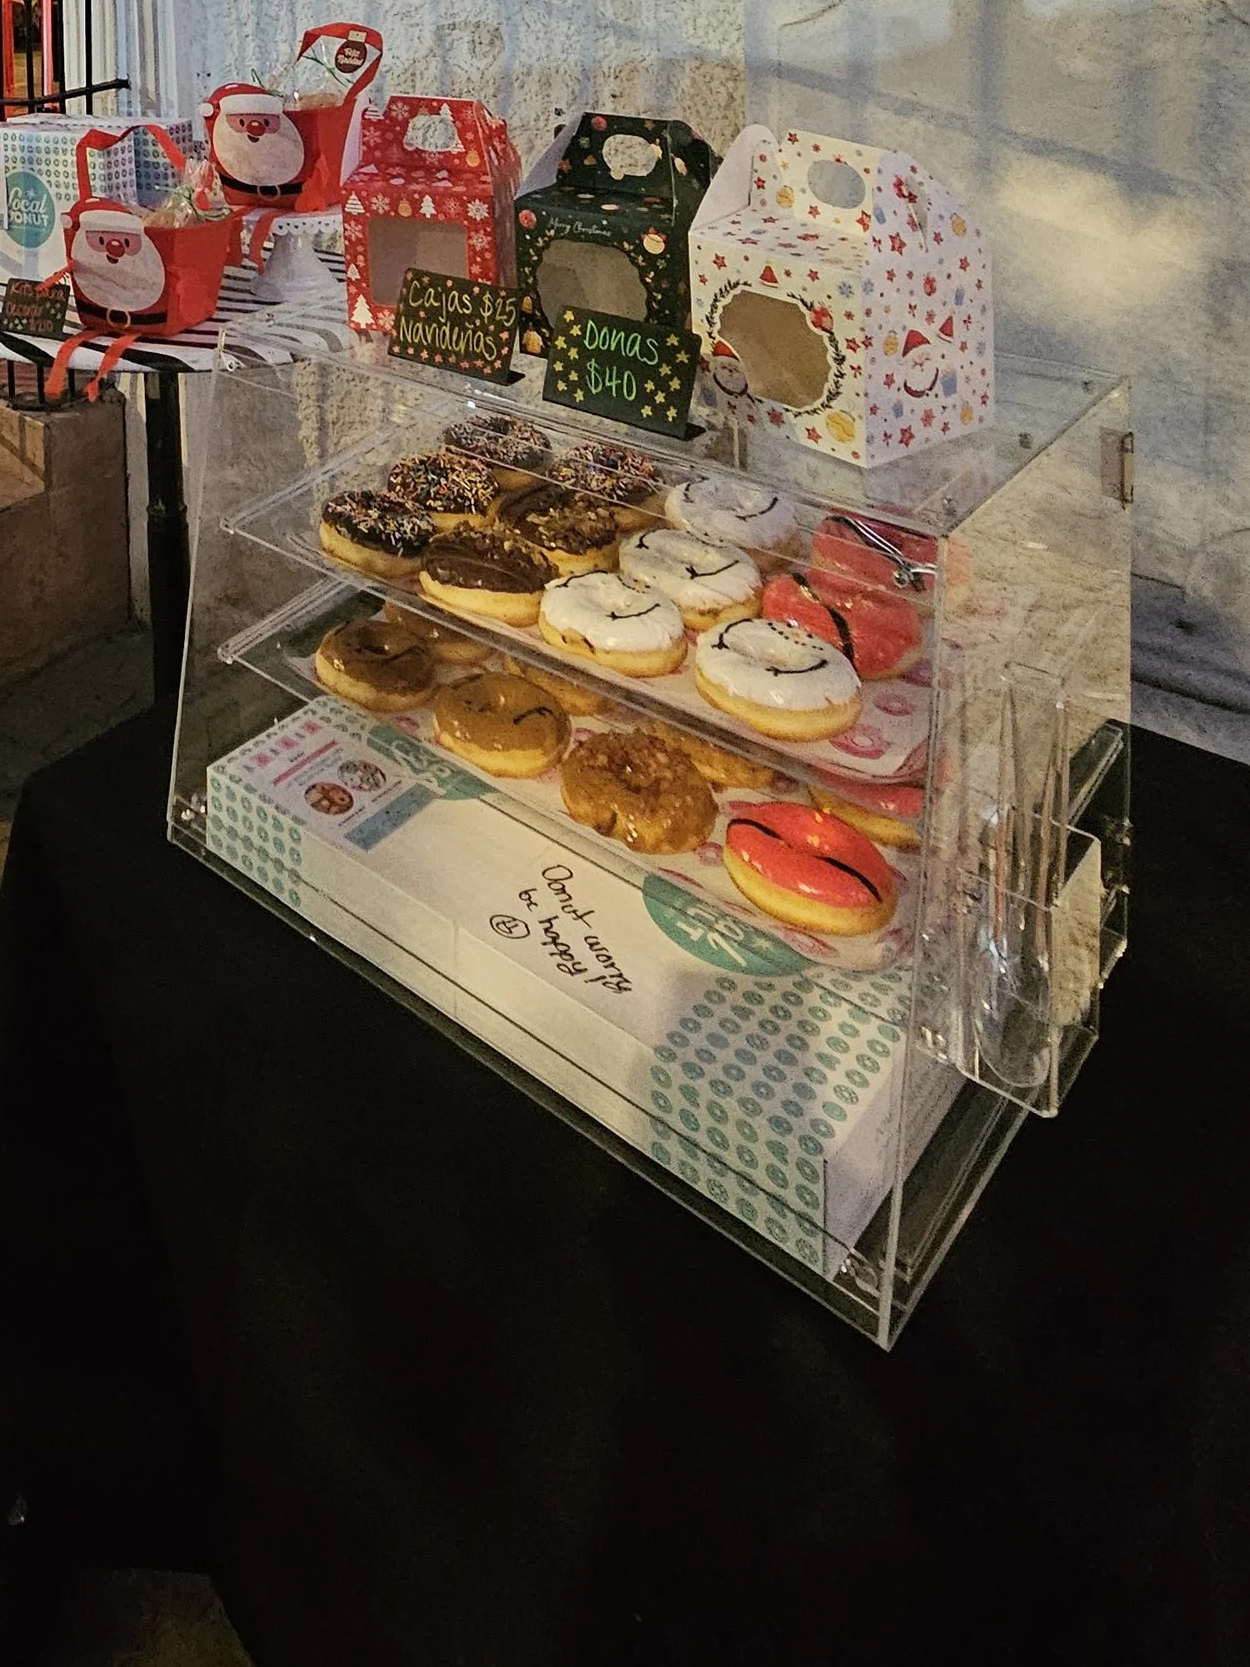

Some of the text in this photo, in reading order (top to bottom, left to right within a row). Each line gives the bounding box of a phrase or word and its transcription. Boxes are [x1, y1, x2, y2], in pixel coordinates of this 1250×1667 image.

[8, 186, 47, 213] Local
[409, 280, 516, 327] Cajas $25
[583, 318, 659, 365] Donas
[585, 358, 637, 401] $40
[518, 888, 538, 912] be
[584, 935, 633, 994] worry
